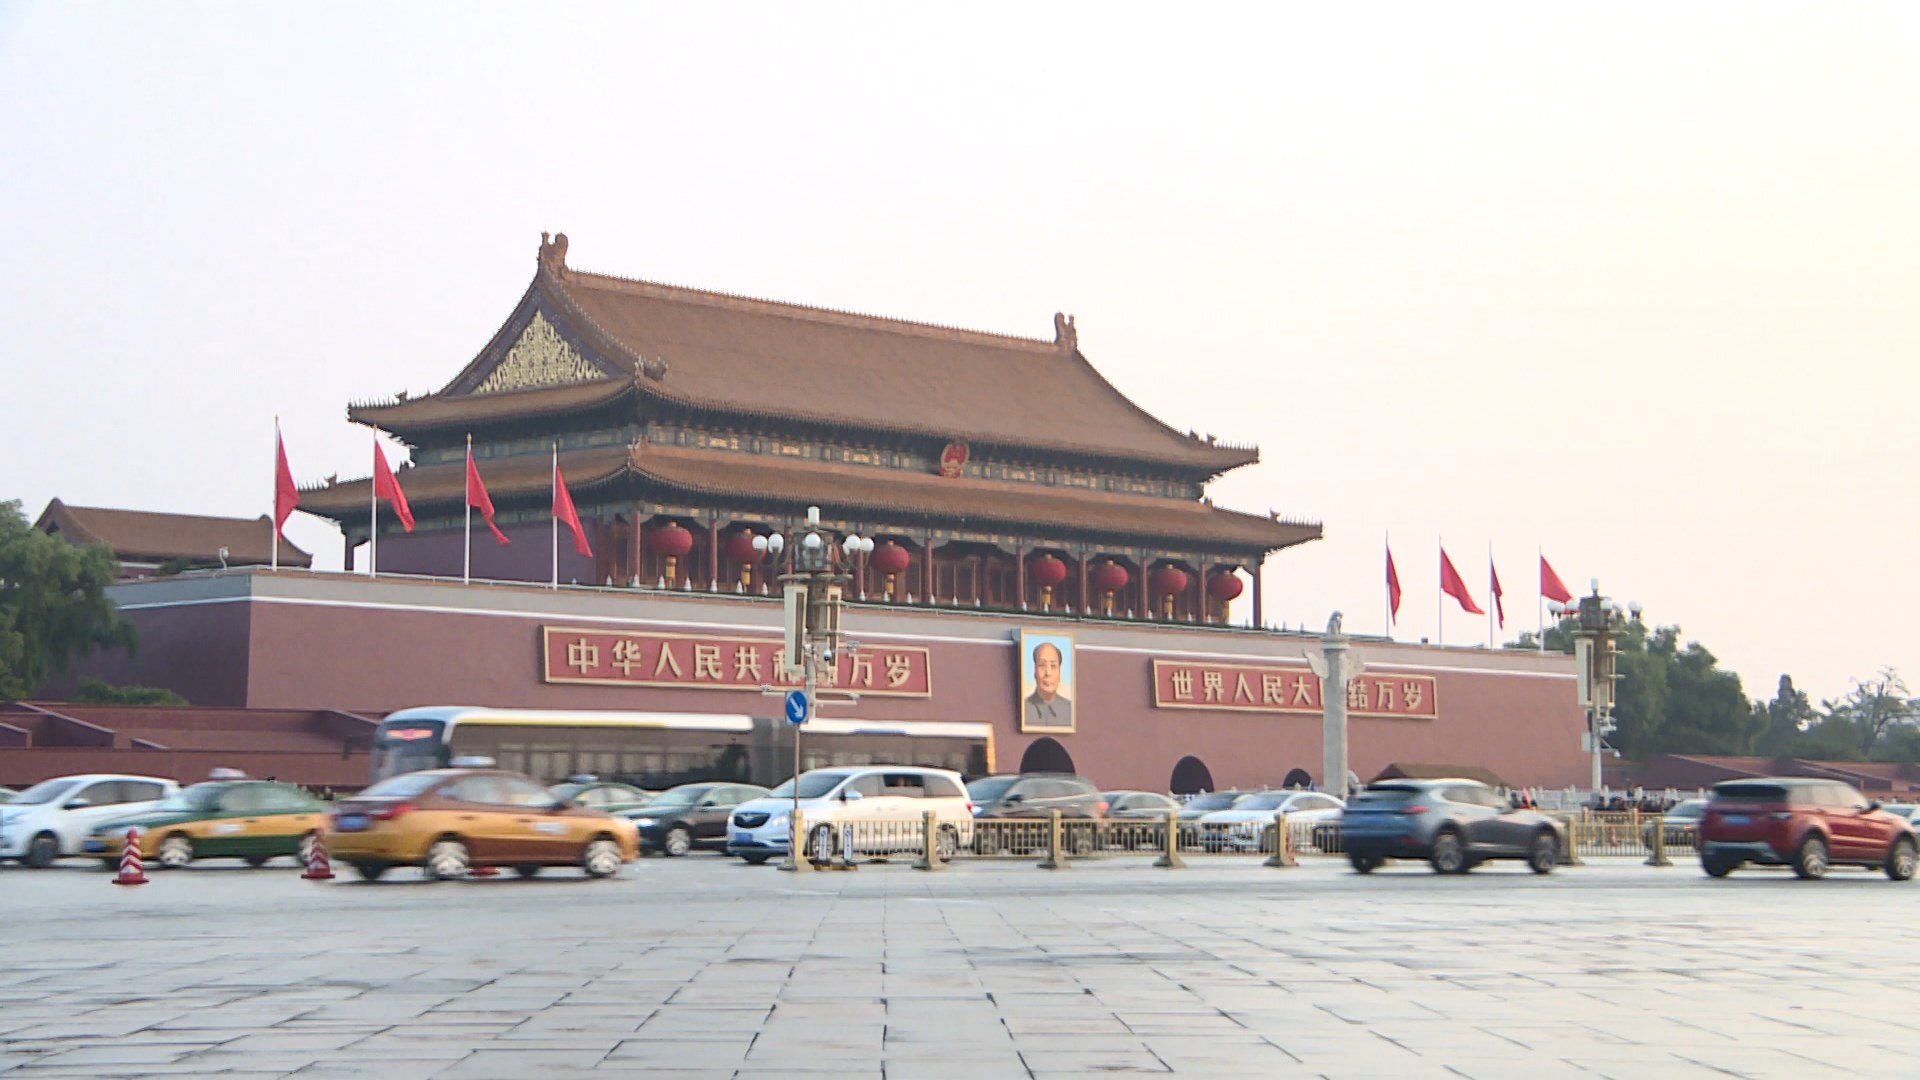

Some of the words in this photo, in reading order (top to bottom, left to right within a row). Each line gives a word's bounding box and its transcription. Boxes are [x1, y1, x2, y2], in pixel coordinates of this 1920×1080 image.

[1172, 669, 1423, 711] 世界人民大结万岁
